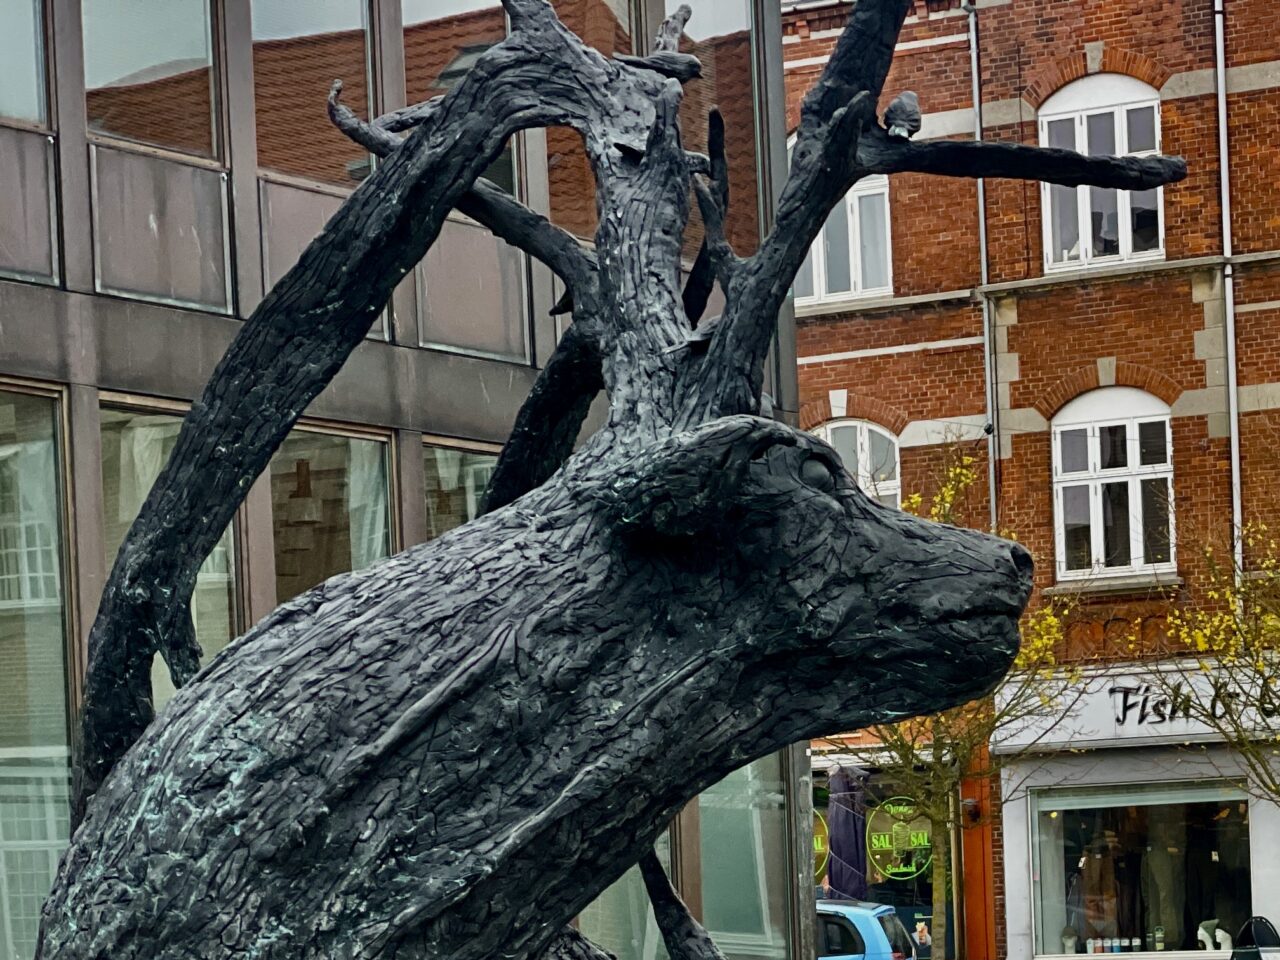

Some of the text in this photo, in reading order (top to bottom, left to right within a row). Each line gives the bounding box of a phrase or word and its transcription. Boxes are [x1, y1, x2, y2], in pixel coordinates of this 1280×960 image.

[1109, 682, 1192, 726] Fish
[813, 837, 824, 850] AL
[872, 832, 931, 849] SAL SAL
